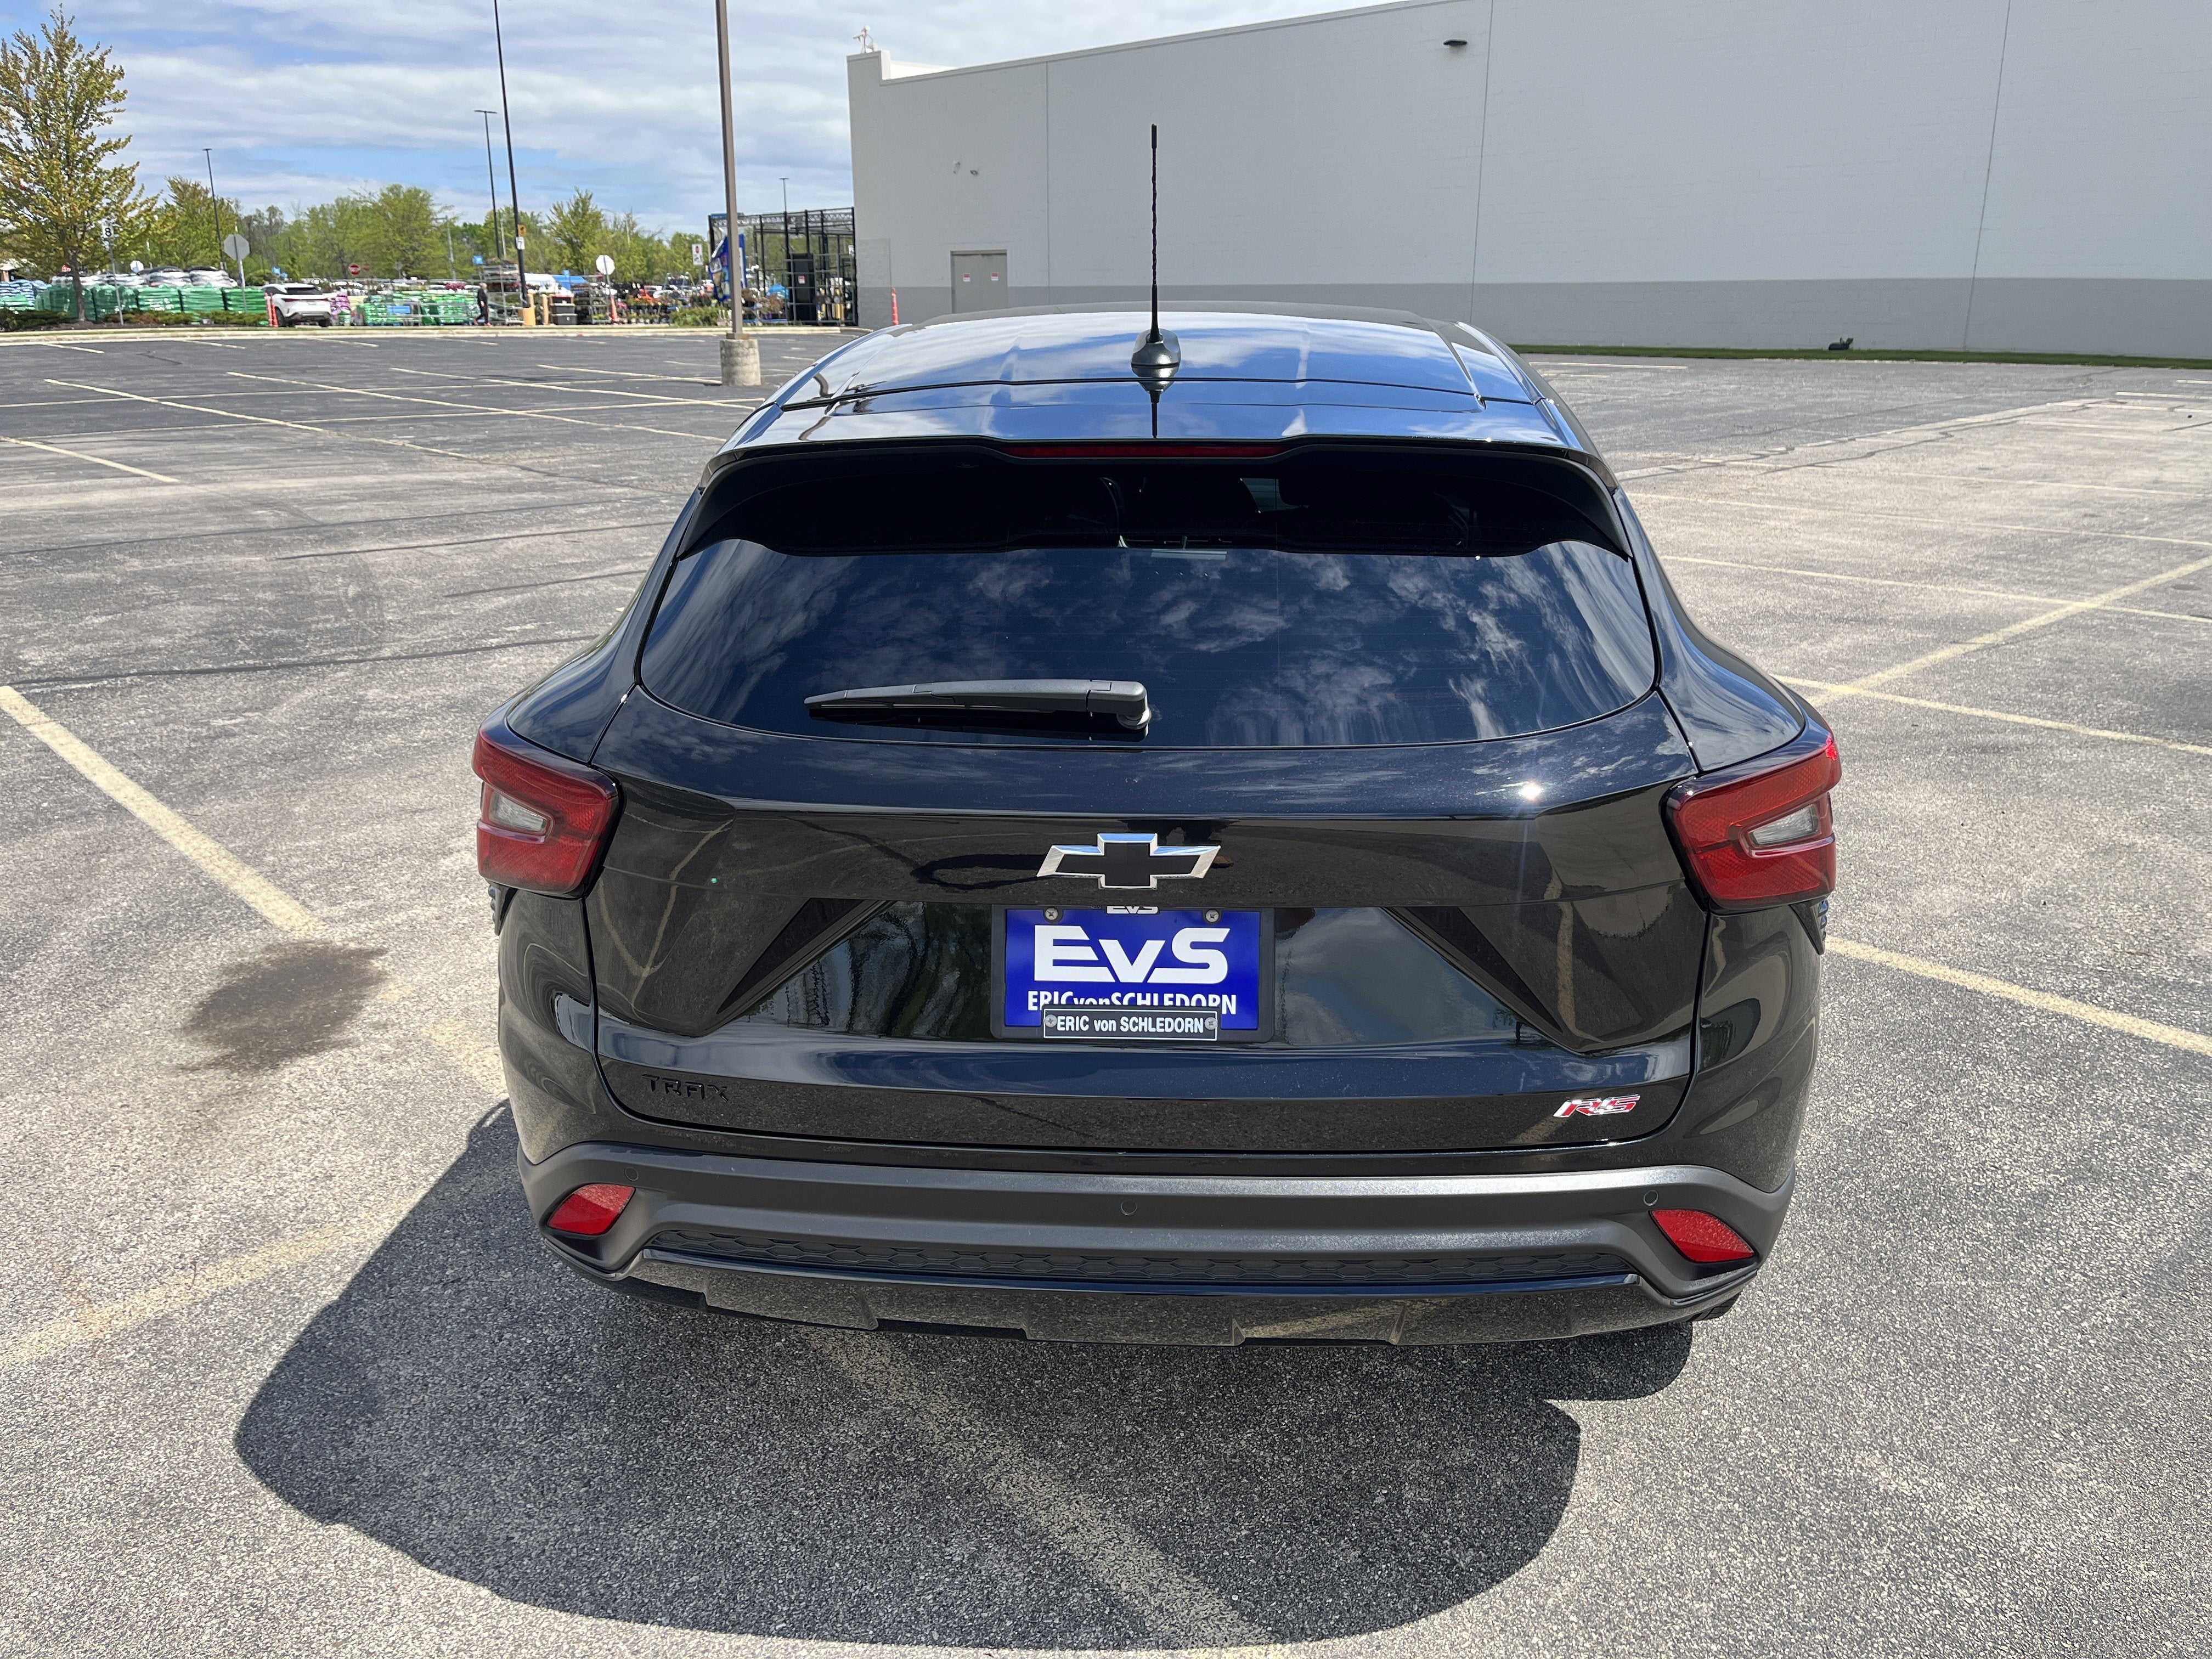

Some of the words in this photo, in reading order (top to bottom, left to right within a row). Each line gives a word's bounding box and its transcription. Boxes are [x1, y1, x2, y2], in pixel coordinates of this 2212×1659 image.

[1057, 1015, 1090, 1031] ERIC
[1093, 1019, 1117, 1032] von
[1120, 1016, 1204, 1033] SCHLEDORN
[641, 1073, 729, 1103] TRAX
[1553, 1094, 1641, 1118] RS
